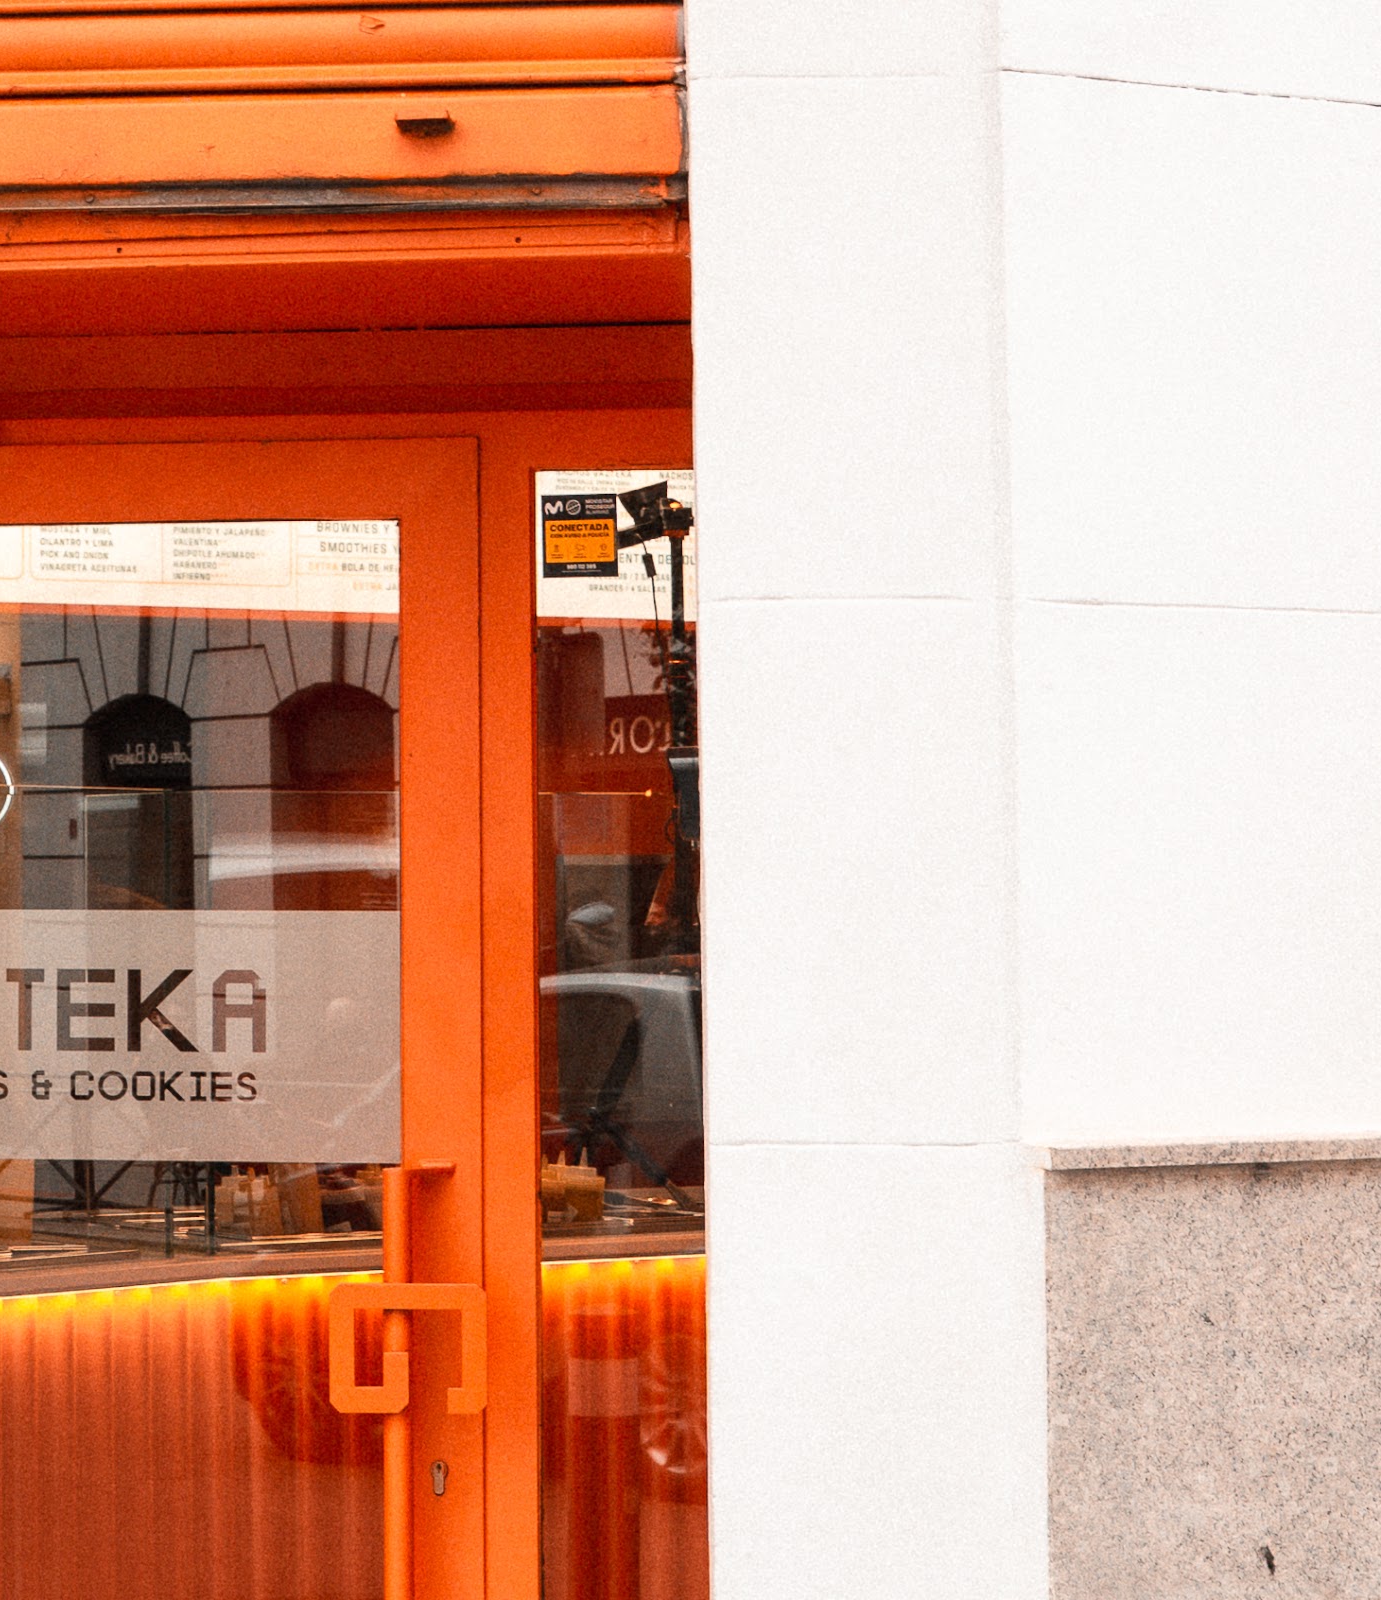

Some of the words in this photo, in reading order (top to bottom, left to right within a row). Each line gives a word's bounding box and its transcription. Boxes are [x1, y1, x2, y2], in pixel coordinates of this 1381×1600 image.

[173, 526, 212, 535] PIMIENTO
[316, 522, 378, 534] BROWNIES
[383, 524, 389, 533] Y
[550, 523, 610, 532] CONECTADA
[40, 538, 81, 546] CILANTRO
[93, 539, 114, 547] LIMA
[320, 542, 387, 554] SMOOTHIES
[173, 549, 212, 557] CHIPOTLE
[40, 563, 87, 571] VINAGRETA
[91, 564, 137, 573] ACEITUNAS
[341, 563, 364, 572] BOLA
[368, 564, 379, 572] DE
[31, 1070, 52, 1100] &
[70, 1070, 257, 1102] COOKIES
